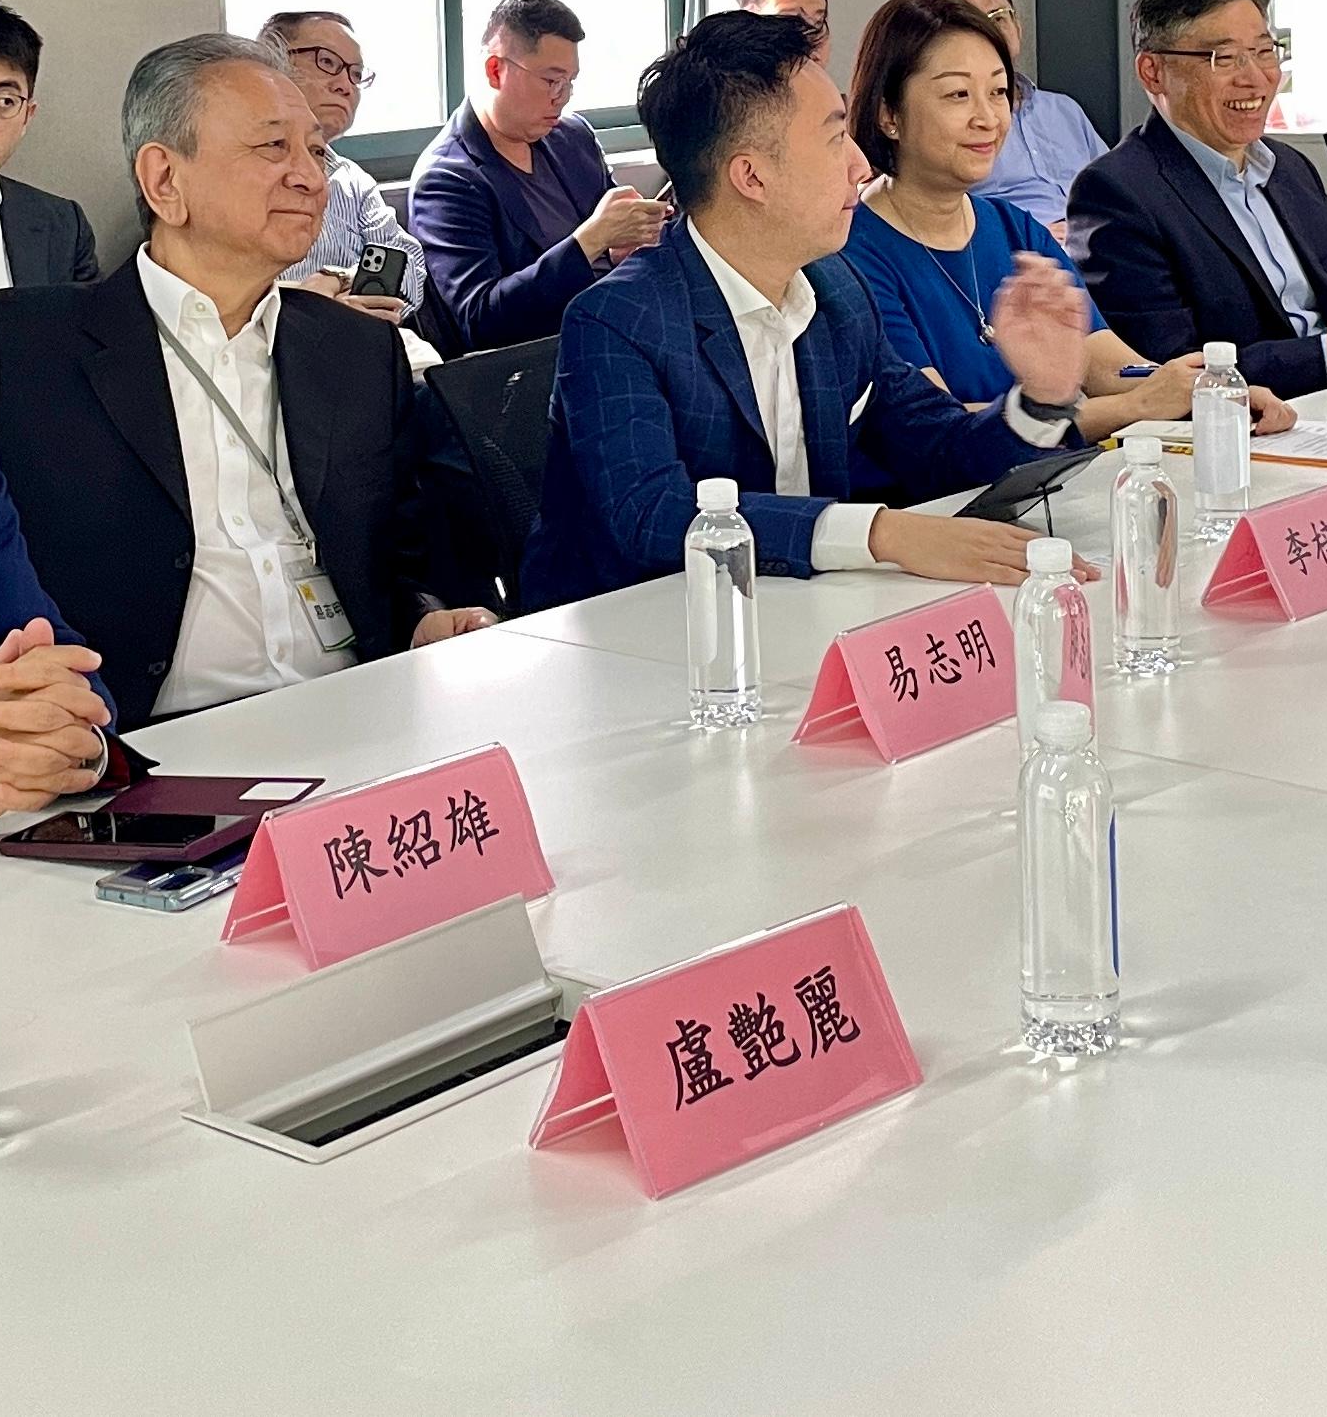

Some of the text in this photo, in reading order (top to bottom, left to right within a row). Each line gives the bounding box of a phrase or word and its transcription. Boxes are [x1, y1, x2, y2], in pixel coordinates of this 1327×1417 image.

[884, 619, 996, 702] 易志明
[324, 789, 500, 899] 陳紹雄
